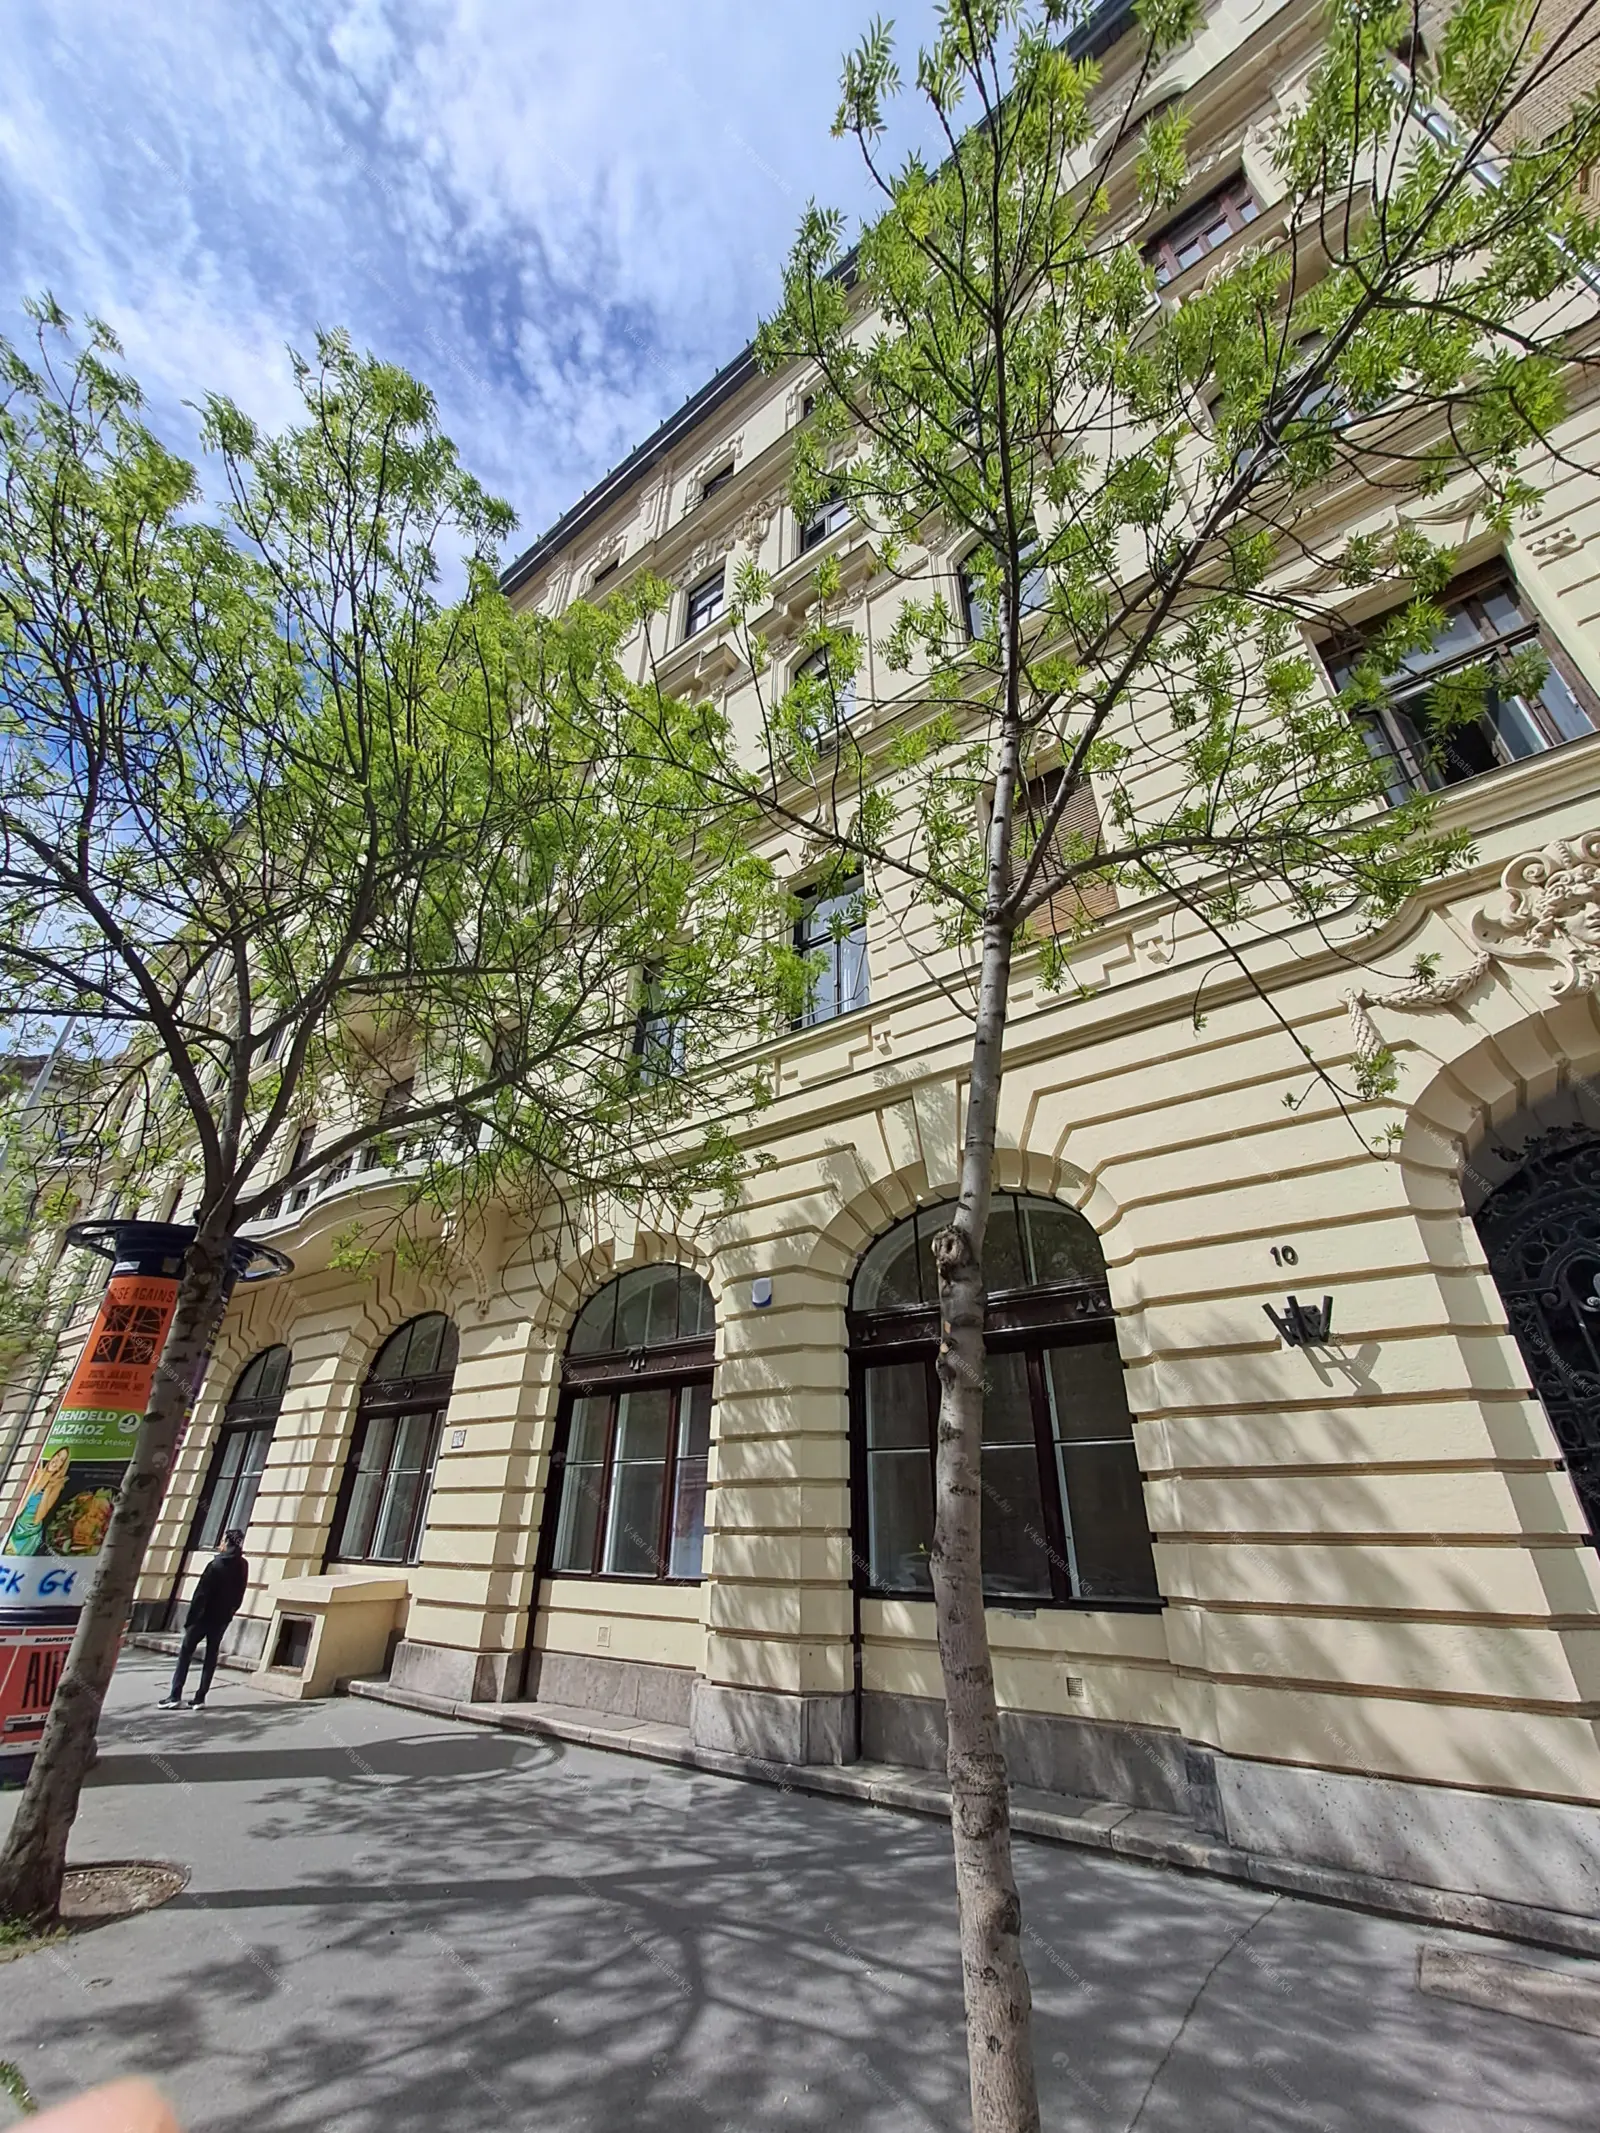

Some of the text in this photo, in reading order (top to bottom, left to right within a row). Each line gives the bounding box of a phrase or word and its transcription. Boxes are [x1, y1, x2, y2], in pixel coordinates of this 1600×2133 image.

[1269, 1245, 1299, 1267] 10
[131, 1287, 176, 1303] AGAINS
[57, 1410, 118, 1421] RENDELD
[52, 1422, 106, 1435] HÁZHOZ
